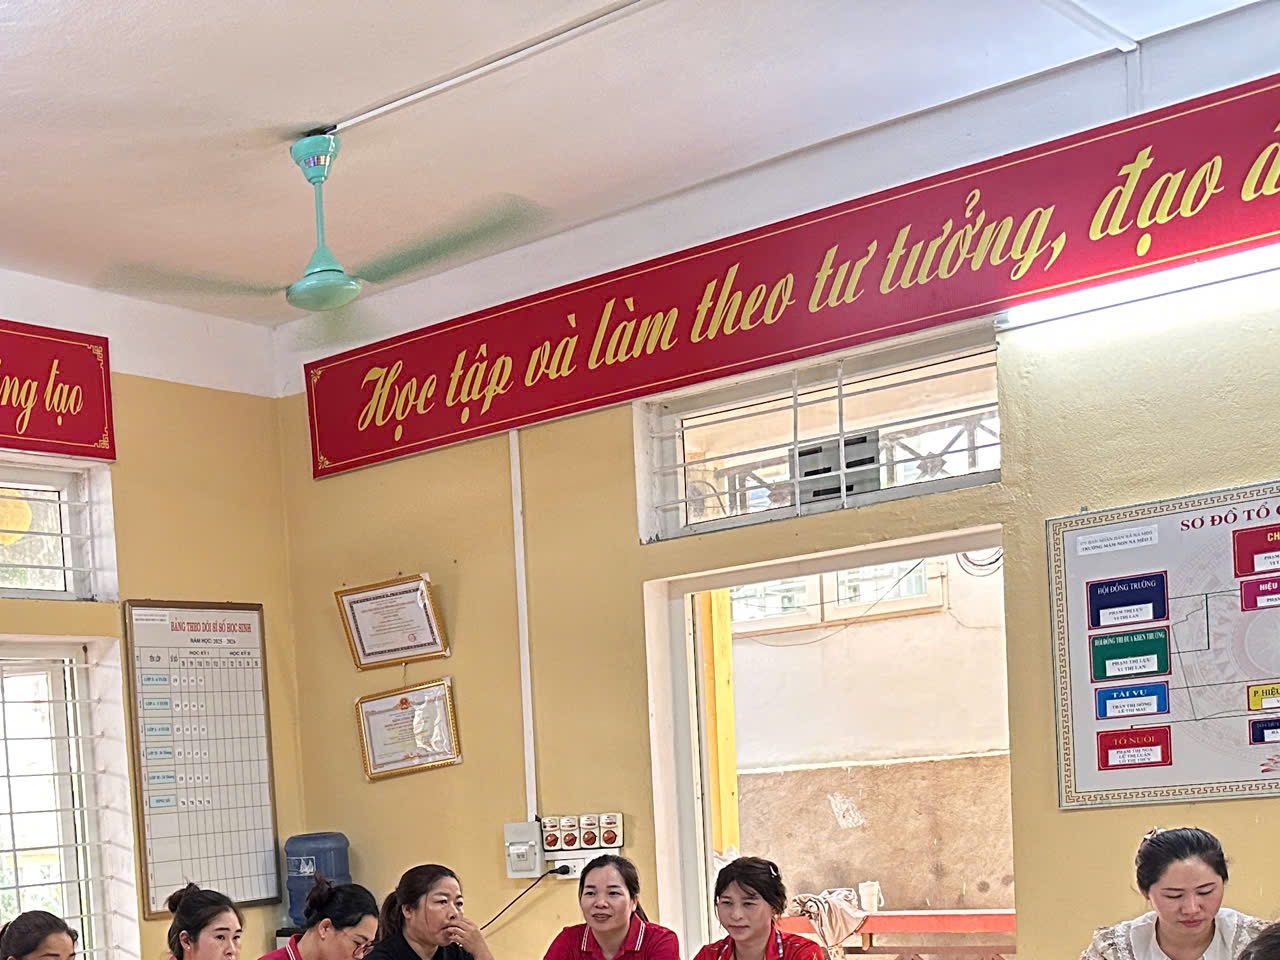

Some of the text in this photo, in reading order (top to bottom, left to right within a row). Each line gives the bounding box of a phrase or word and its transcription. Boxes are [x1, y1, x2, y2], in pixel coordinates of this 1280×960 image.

[358, 360, 436, 442] Học
[446, 344, 514, 424] tập
[524, 313, 580, 387] và
[588, 297, 678, 370] làm
[690, 263, 796, 344] theo
[808, 240, 878, 313] tư
[880, 188, 1066, 280] tưởng,
[1089, 145, 1224, 256] đạo
[43, 358, 83, 426] tạo
[1180, 502, 1270, 532] SƠ ĐỒ TỔ
